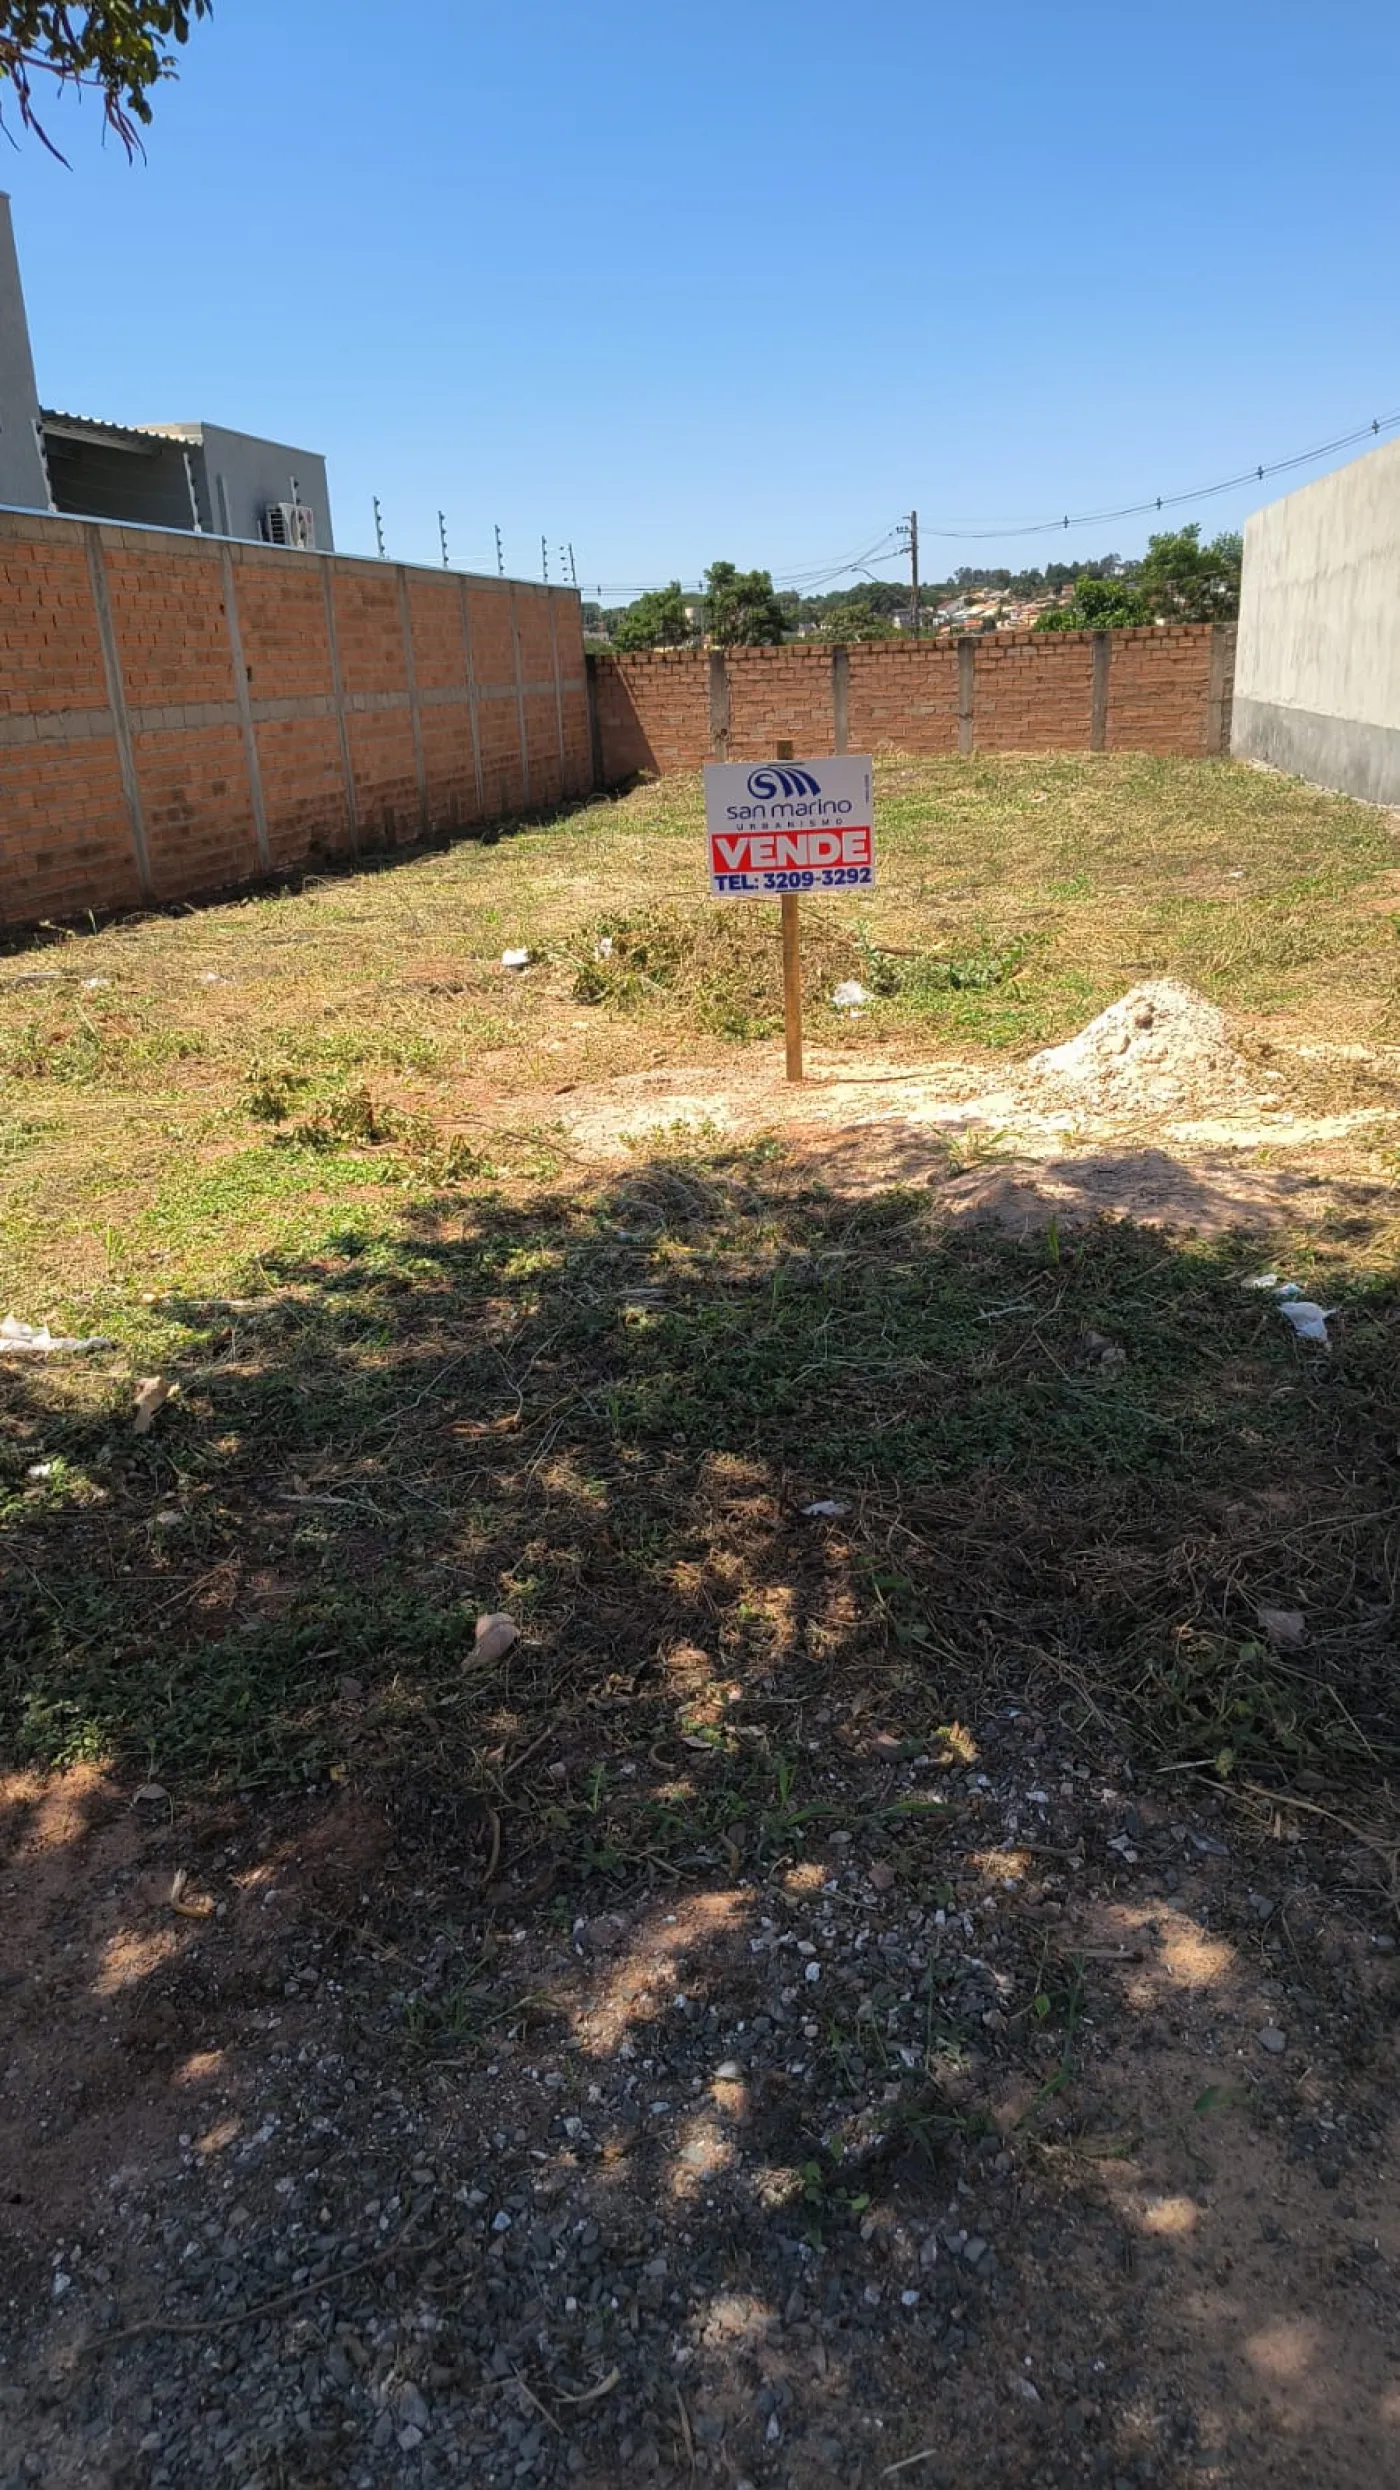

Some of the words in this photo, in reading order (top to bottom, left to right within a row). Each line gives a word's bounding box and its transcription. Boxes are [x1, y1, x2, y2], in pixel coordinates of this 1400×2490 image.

[726, 804, 766, 820] san
[771, 798, 853, 818] marino
[736, 818, 844, 831] URBANISMO
[714, 830, 869, 870] VENDE
[714, 874, 760, 891] TEL:
[763, 867, 872, 889] 3209-3292
